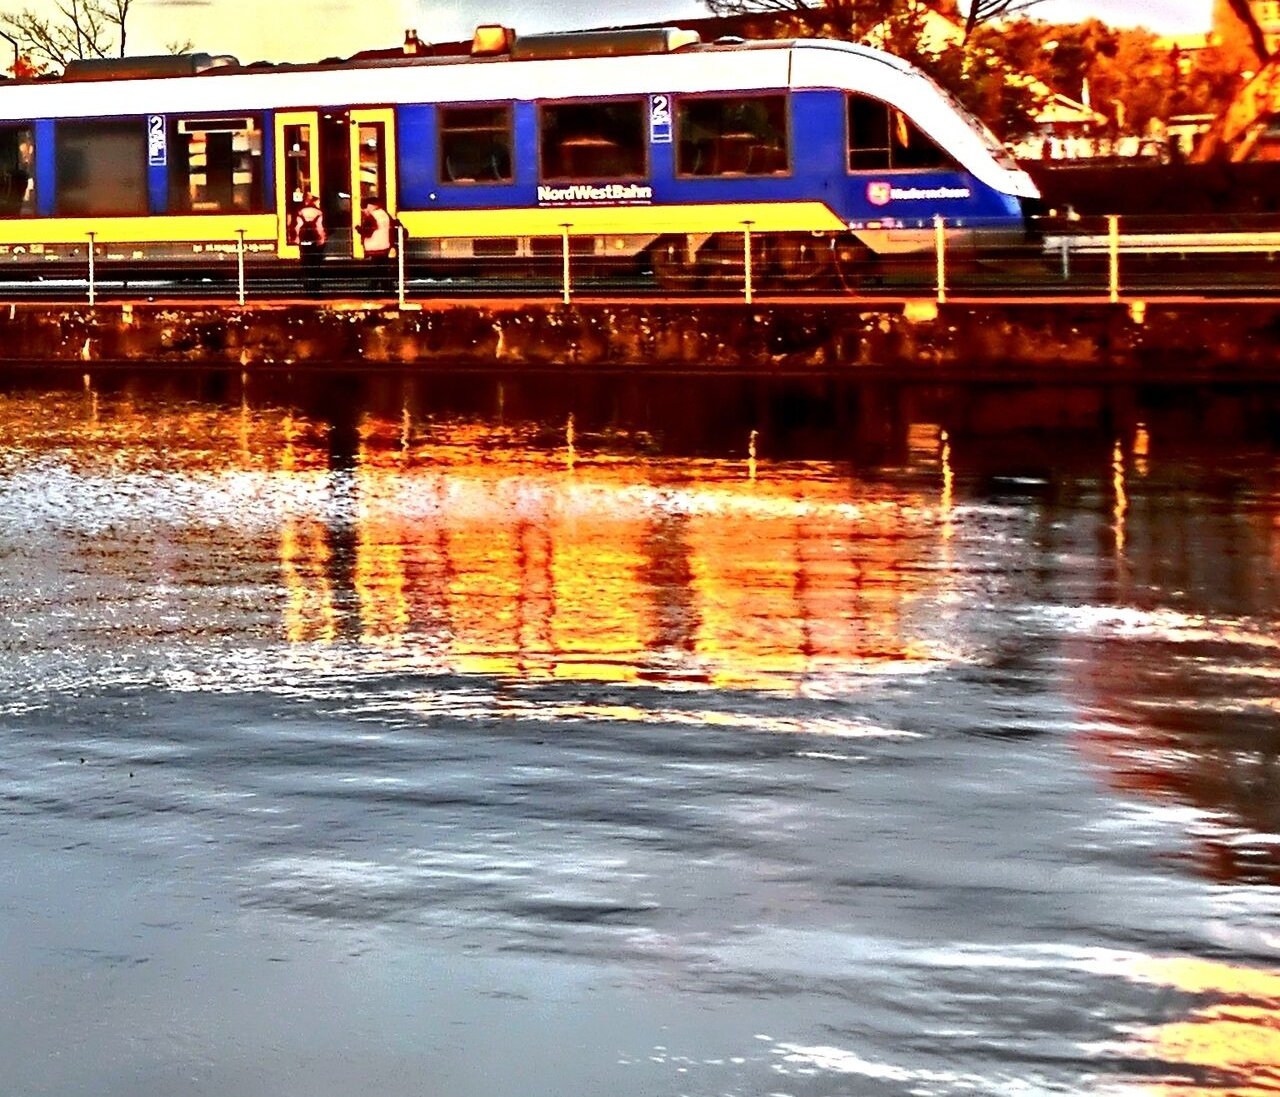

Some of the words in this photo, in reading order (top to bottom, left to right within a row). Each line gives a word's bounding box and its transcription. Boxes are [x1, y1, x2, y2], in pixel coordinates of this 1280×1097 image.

[653, 95, 668, 115] 2
[151, 116, 163, 134] 2
[537, 184, 652, 201] NordWestBahn
